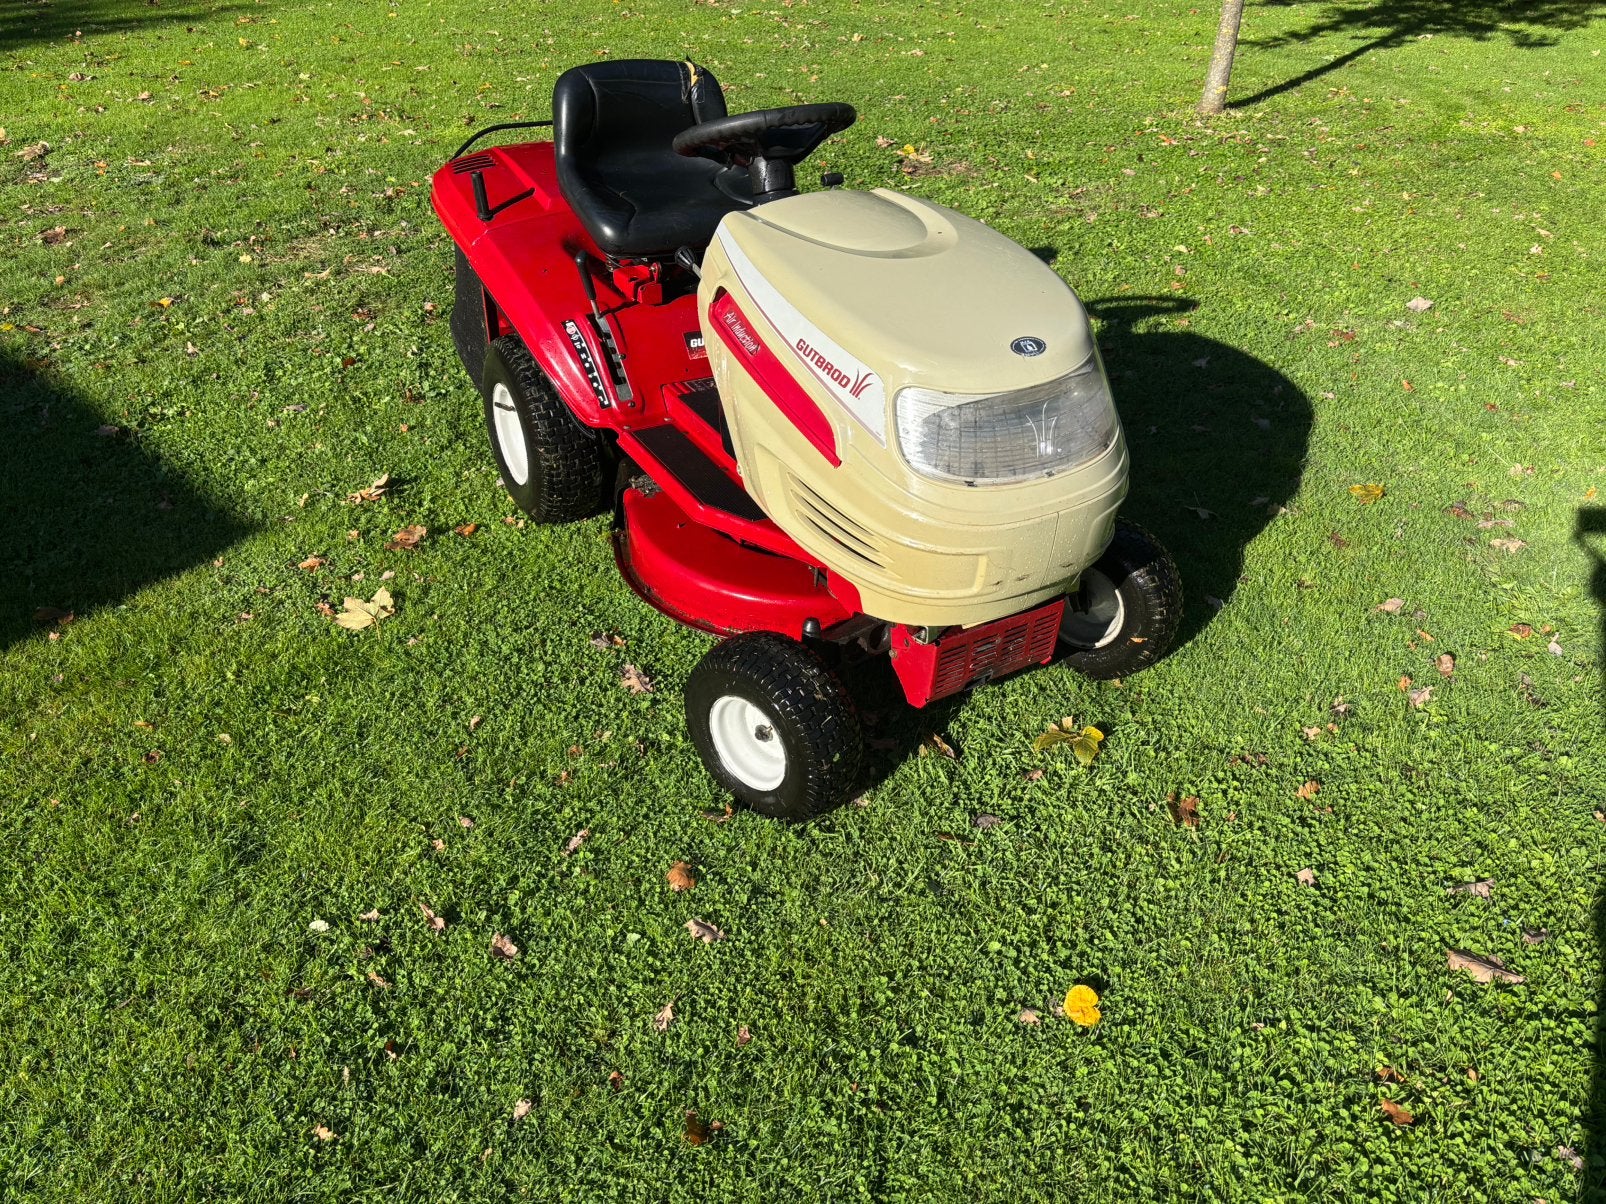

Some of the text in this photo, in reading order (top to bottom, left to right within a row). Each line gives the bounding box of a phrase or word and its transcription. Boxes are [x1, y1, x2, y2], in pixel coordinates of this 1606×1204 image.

[724, 312, 758, 352] Air Induction
[795, 338, 851, 389] GUTBROD
